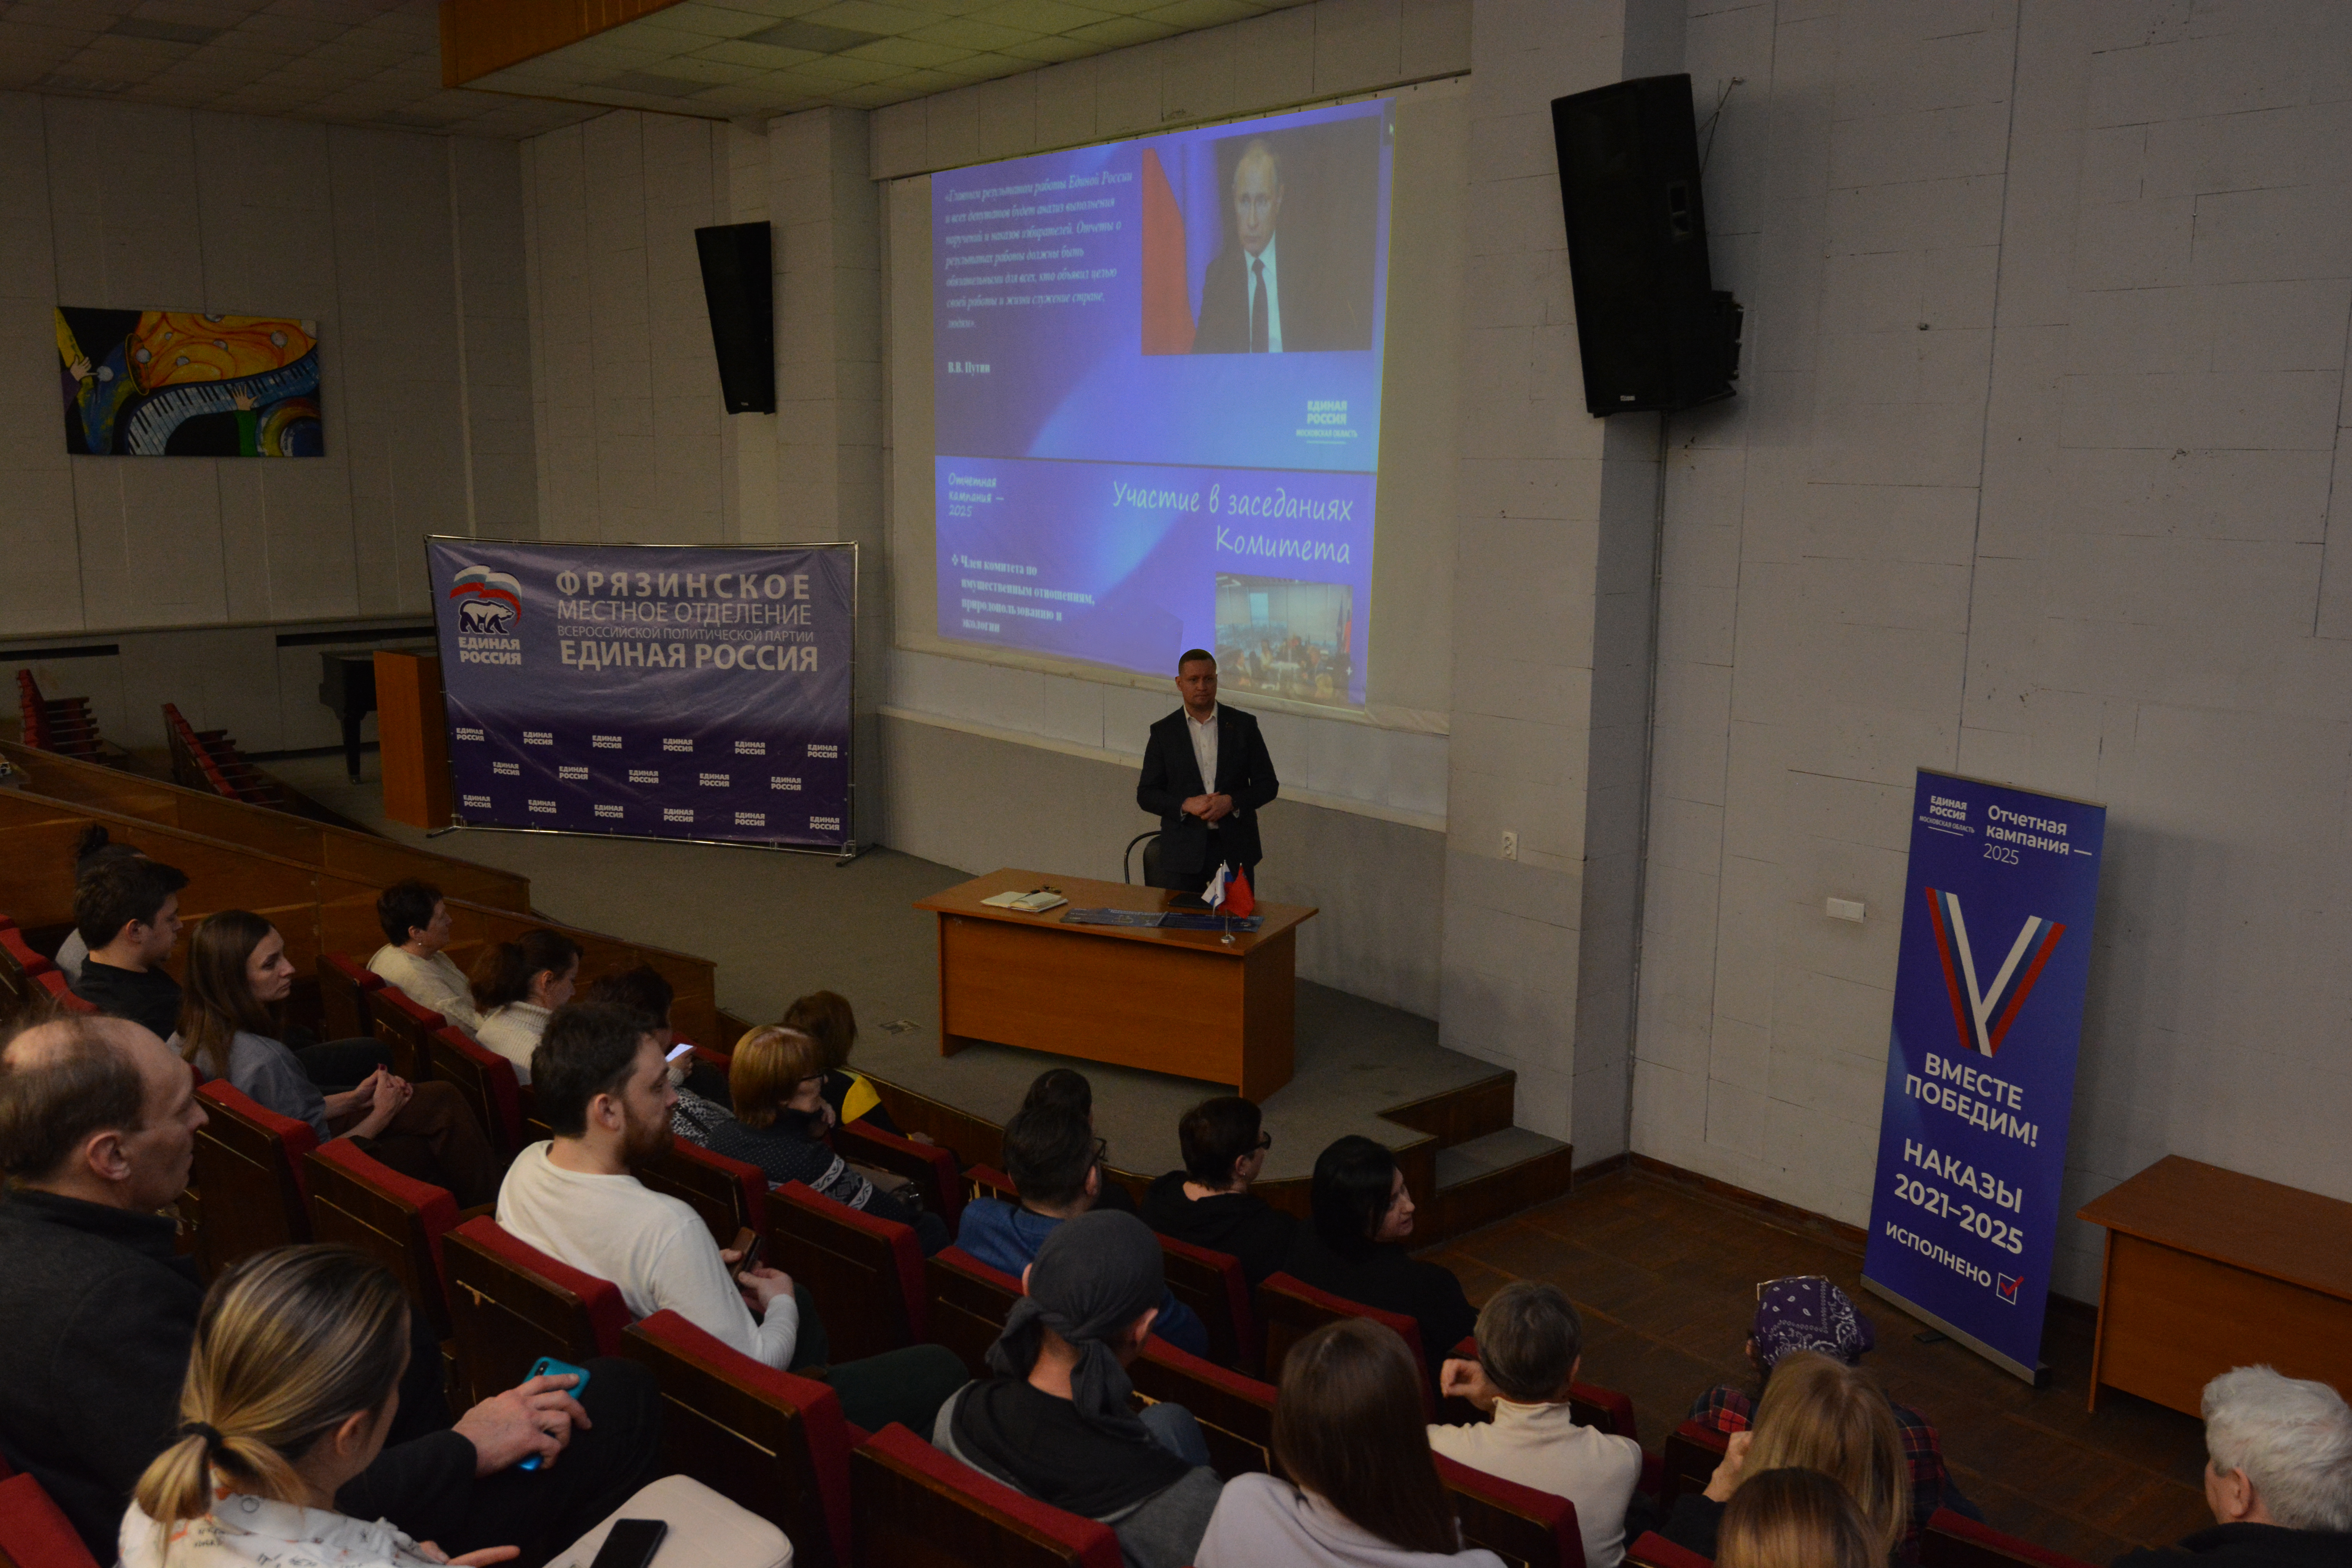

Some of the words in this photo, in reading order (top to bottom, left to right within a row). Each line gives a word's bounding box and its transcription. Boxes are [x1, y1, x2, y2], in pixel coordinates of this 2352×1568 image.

[1034, 178, 1066, 196] работы
[1069, 173, 1099, 188] Единой
[1102, 171, 1132, 185] России
[951, 213, 967, 223] всех
[1011, 204, 1035, 220] будет
[1037, 203, 1064, 214] анализ
[1065, 198, 1115, 212] выполнения
[984, 233, 989, 241] и
[1077, 221, 1114, 234] Отчеты
[1116, 220, 1122, 230] о
[994, 249, 1025, 267] работы
[1026, 249, 1059, 260] должны
[1061, 245, 1084, 258] быть
[1005, 272, 1018, 284] для
[1039, 272, 1055, 281] кто
[1057, 268, 1089, 281] объявил
[1091, 268, 1117, 281] целью
[946, 296, 966, 308] своей
[967, 294, 997, 311] работы
[998, 297, 1004, 306] и
[1005, 296, 1031, 305] жизни
[1032, 294, 1071, 308] служение
[948, 362, 963, 373] В.В.
[965, 362, 991, 376] Путин
[1308, 400, 1347, 413] ЕДИНАЯ
[1307, 413, 1347, 425] РОССИЯ
[949, 491, 991, 503] кампания
[1113, 481, 1200, 512] Участие
[1209, 484, 1220, 513] в
[1227, 487, 1353, 521] заседаниях
[949, 505, 973, 517] 2025
[1216, 525, 1350, 564] Комитета
[961, 555, 982, 569] Член
[984, 561, 1024, 574] комитета
[1026, 566, 1038, 575] по
[556, 570, 809, 599] ФРЯЗИНСКОЕ
[962, 579, 1032, 596] имущественным
[1034, 589, 1095, 606] отношениям,
[558, 600, 668, 622] МЕСТНОЕ
[675, 602, 811, 627] ОТДЕЛЕНИЕ
[962, 598, 1054, 620] природопользованию
[1056, 612, 1062, 621] и
[459, 637, 520, 650] ЕДИНАЯ
[558, 625, 660, 639] ВСЕРОССИЙСКОЙ
[664, 628, 761, 641] ПОЛИТИЧЕСКОЙ
[766, 631, 813, 642] ПАРТИИ
[460, 651, 521, 665] РОССИЯ
[561, 640, 685, 671] ЕДИНАЯ
[695, 644, 817, 671] РОССИЯ
[1930, 806, 1965, 821] РОССИЯ
[1931, 795, 1967, 811] ЕДИНАЯ
[1919, 815, 1951, 828] МОСКОВСКАЯ
[1952, 823, 1975, 833] ОБЛАСТЬ
[1988, 805, 2067, 835] Отчетная
[1986, 826, 2069, 855] кампания
[1984, 844, 2019, 865] 2025
[1925, 1053, 2023, 1110] ВМЕСТЕ
[1906, 1074, 2038, 1147] ПОБЕДИМ!
[1904, 1138, 2022, 1213] НАКАЗЫ
[1886, 1221, 1991, 1287] ИСПОЛНЕНО
